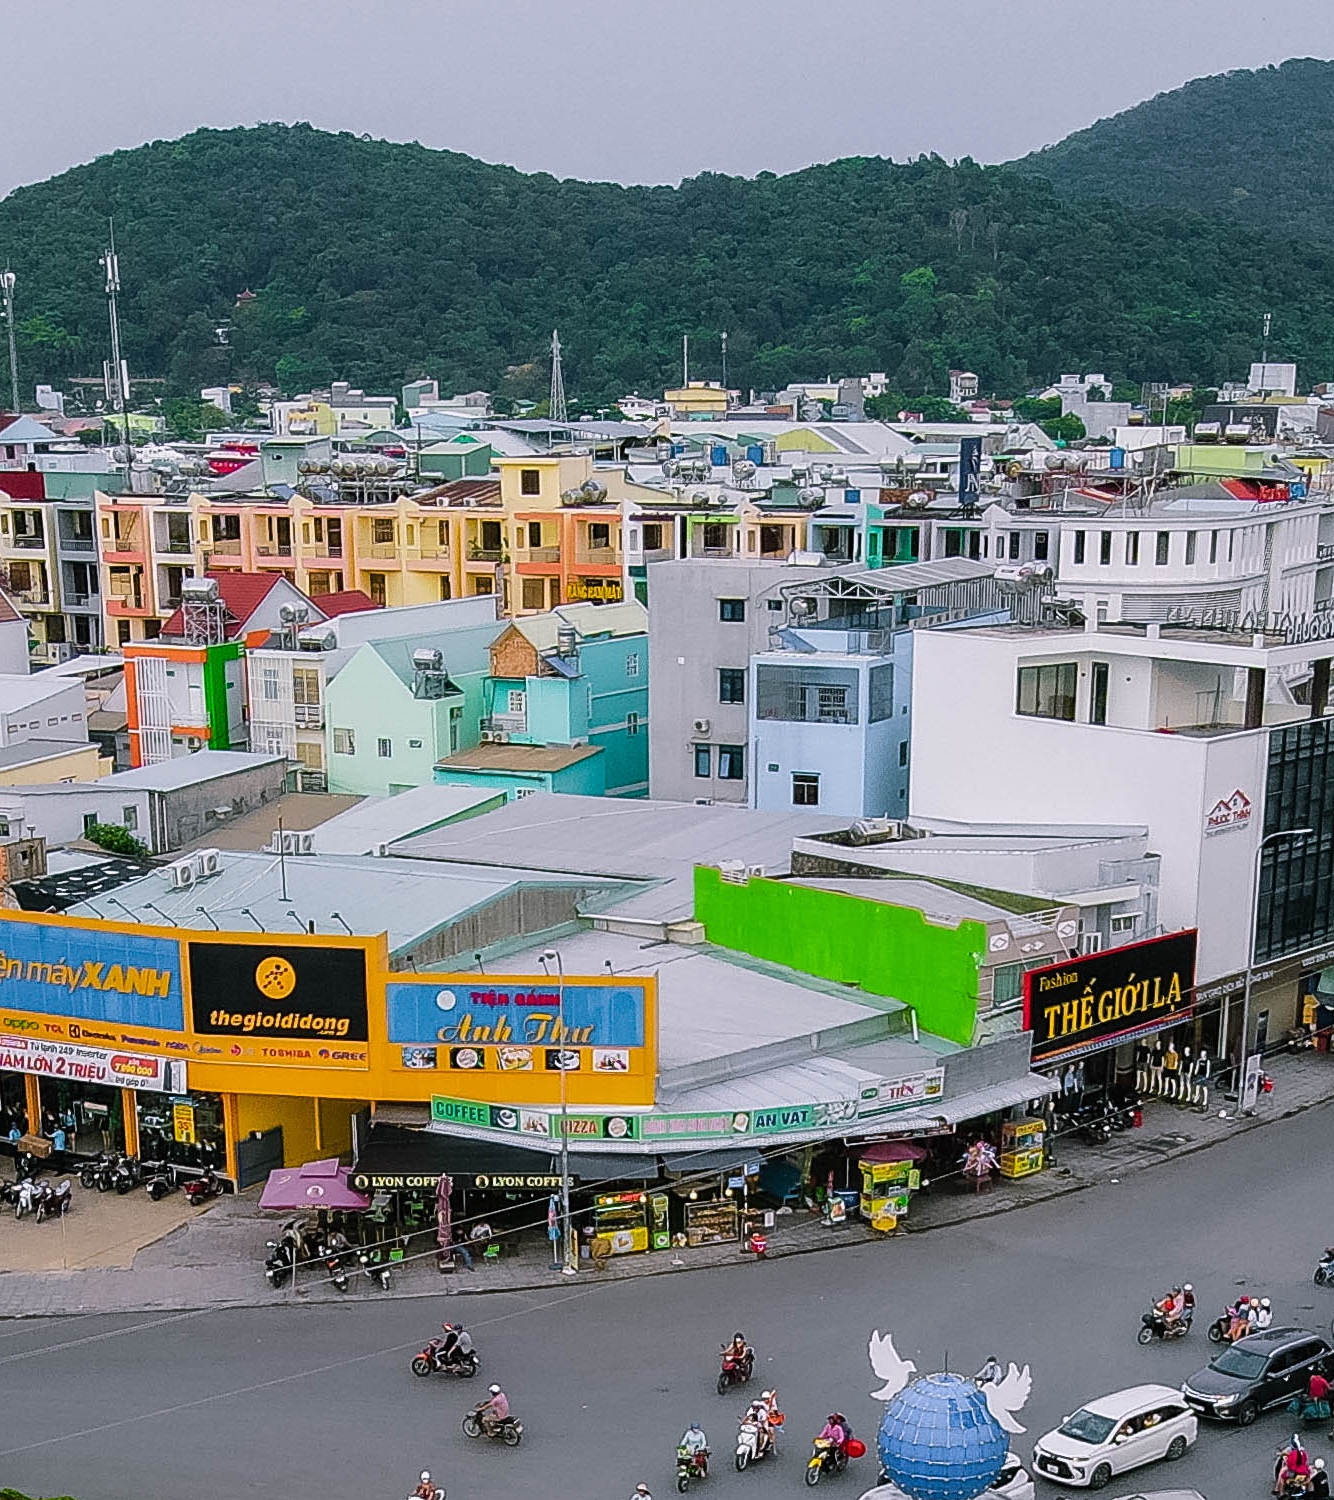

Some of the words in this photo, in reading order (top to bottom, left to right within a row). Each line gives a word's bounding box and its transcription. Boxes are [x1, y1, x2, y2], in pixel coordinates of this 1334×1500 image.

[81, 960, 172, 999] XANH
[1038, 971, 1079, 993] Fashion
[1044, 977, 1098, 1039] THẾ
[1097, 972, 1150, 1028] GIỚI
[1152, 971, 1182, 1012] LẠ
[44, 1023, 65, 1035] TCL
[210, 1009, 351, 1036] thegioididong
[437, 1013, 512, 1043] Anh
[523, 1012, 595, 1043] Thư
[261, 1047, 312, 1059] TOSHIBA
[331, 1051, 367, 1062] GREE
[25, 1053, 53, 1074] LỚN
[55, 1056, 67, 1075] 2
[68, 1060, 107, 1082] TRIỆU
[435, 1101, 486, 1124] COFFEE
[372, 1176, 404, 1187] LYON
[406, 1176, 454, 1188] COFF
[492, 1176, 525, 1187] LYON
